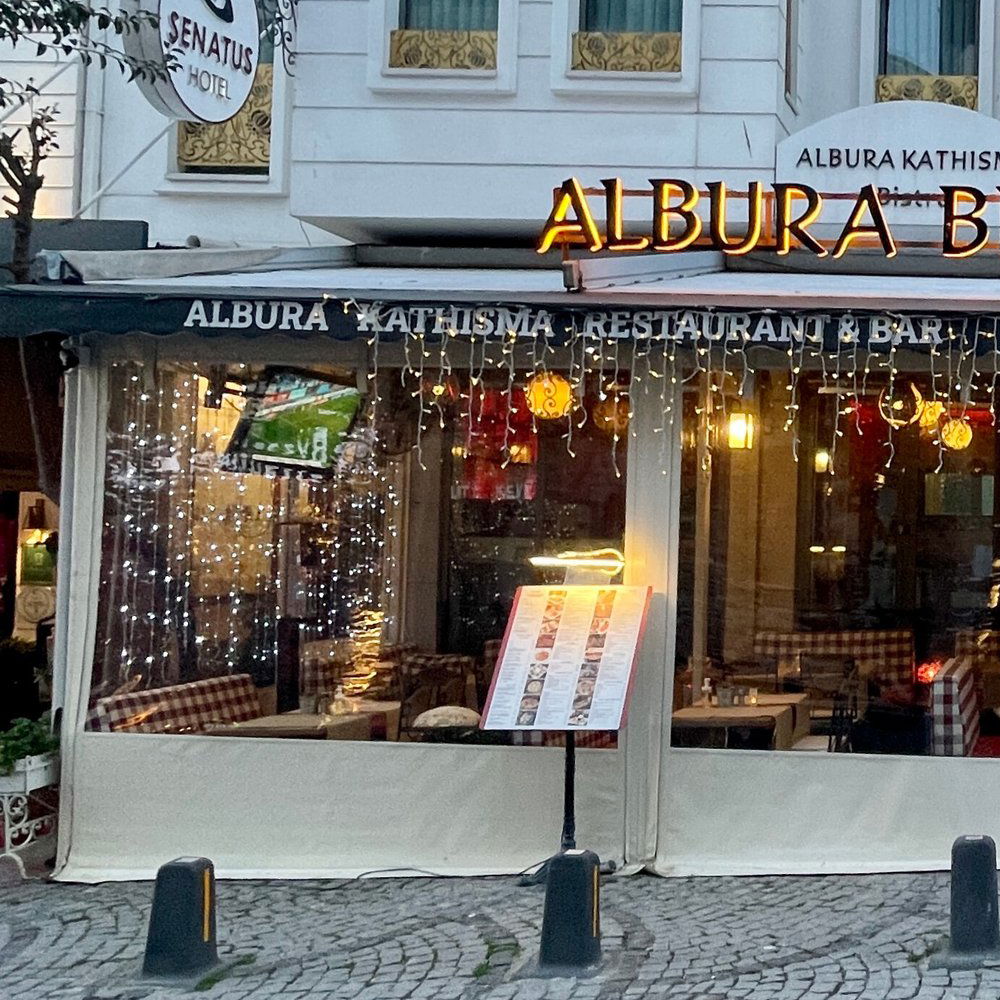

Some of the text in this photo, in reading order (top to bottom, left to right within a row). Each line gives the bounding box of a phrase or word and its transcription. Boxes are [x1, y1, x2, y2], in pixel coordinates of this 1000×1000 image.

[168, 10, 254, 76] SENATUS
[187, 65, 232, 101] HOTEL
[796, 148, 895, 169] ALBURA
[536, 176, 898, 259] ALBURA
[184, 299, 944, 345] ALBURA KATHISMA RESTAURANT & BAR
